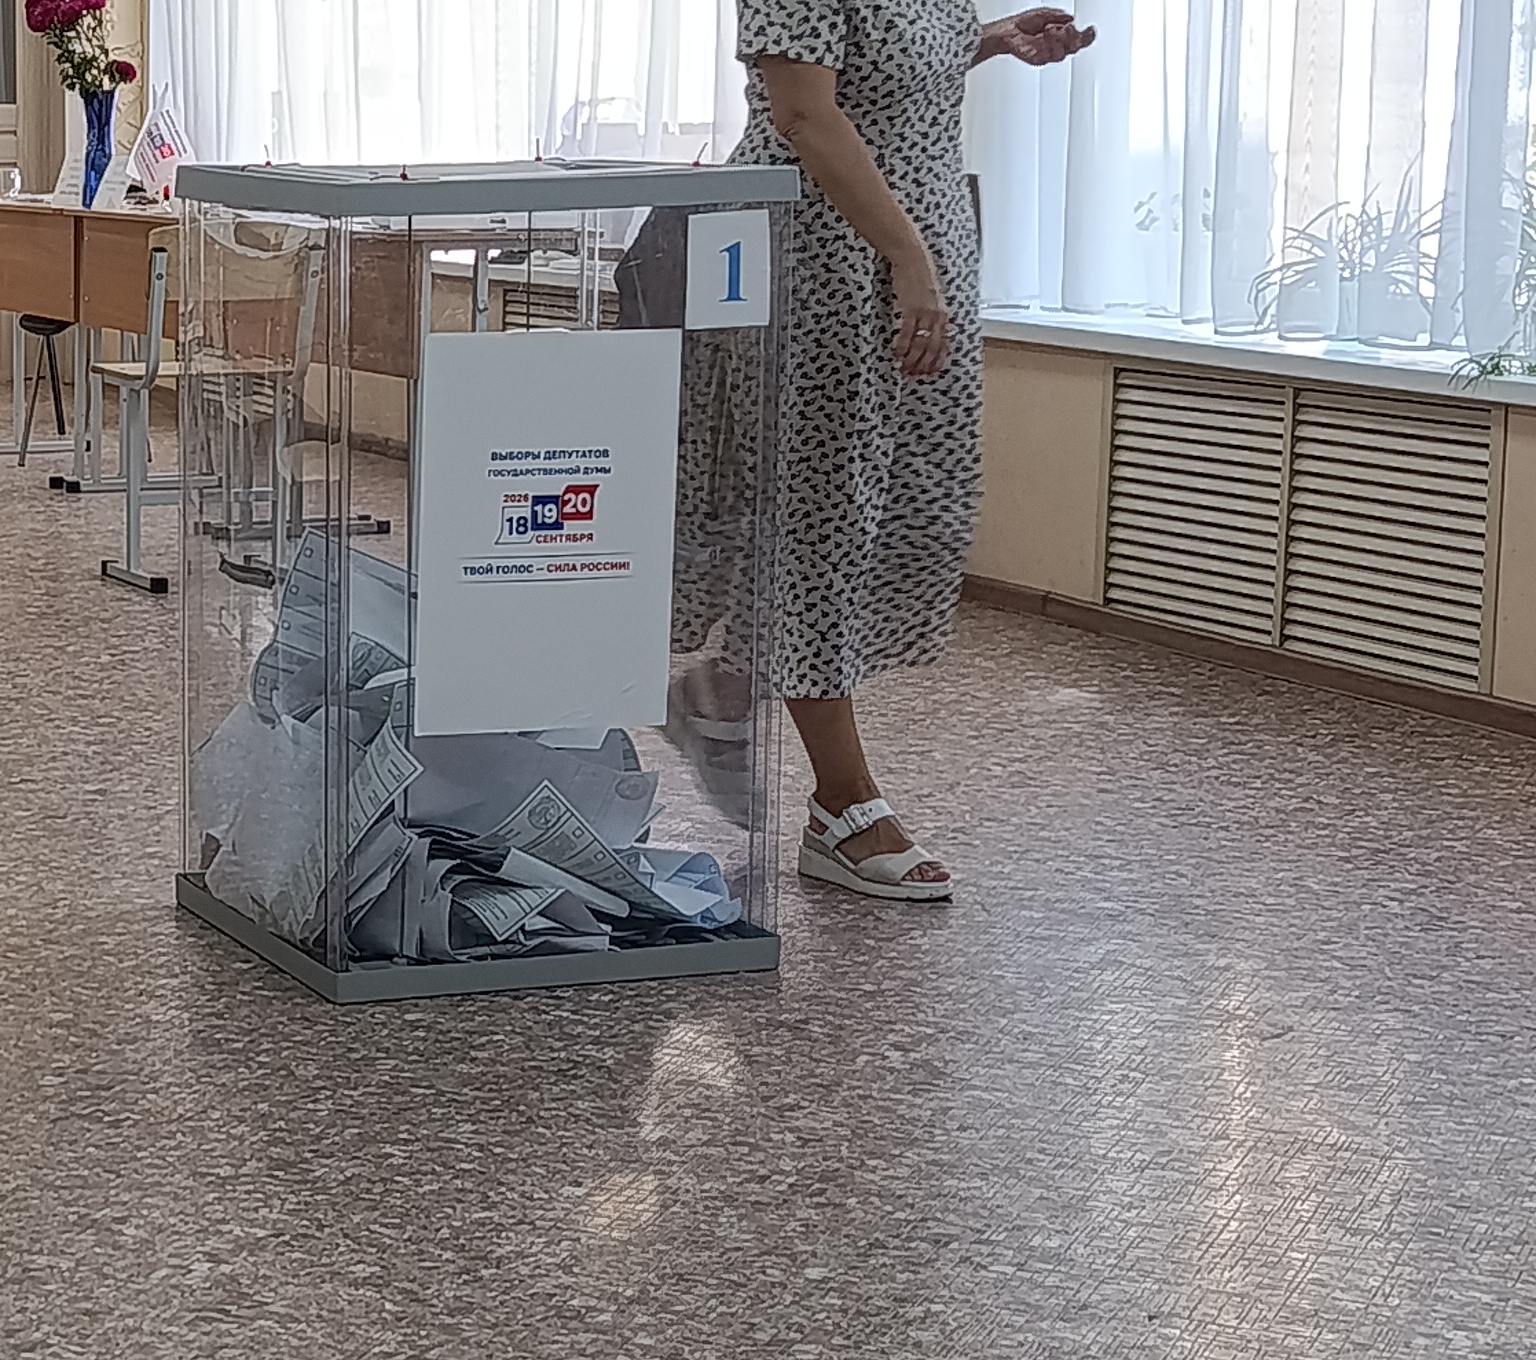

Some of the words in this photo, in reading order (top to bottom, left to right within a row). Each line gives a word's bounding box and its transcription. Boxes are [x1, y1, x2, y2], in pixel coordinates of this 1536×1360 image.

[719, 240, 748, 302] 1
[490, 451, 541, 461] ВЫБОРЫ
[543, 449, 610, 461] ДЕПУТАТОВ
[488, 466, 581, 477] ГОСУДАРСТВЕННОЙ
[582, 467, 611, 476] ДУМЫ
[502, 493, 530, 503] 2026
[506, 516, 529, 535] 18
[533, 504, 558, 524] 19
[562, 492, 592, 513] 20
[535, 533, 593, 544] СЕНТЯБРЯ
[463, 563, 494, 576] ТВОЙ
[496, 564, 534, 574] ГОЛОС
[546, 562, 578, 573] СИЛА
[580, 561, 631, 572] РОССИИ!
